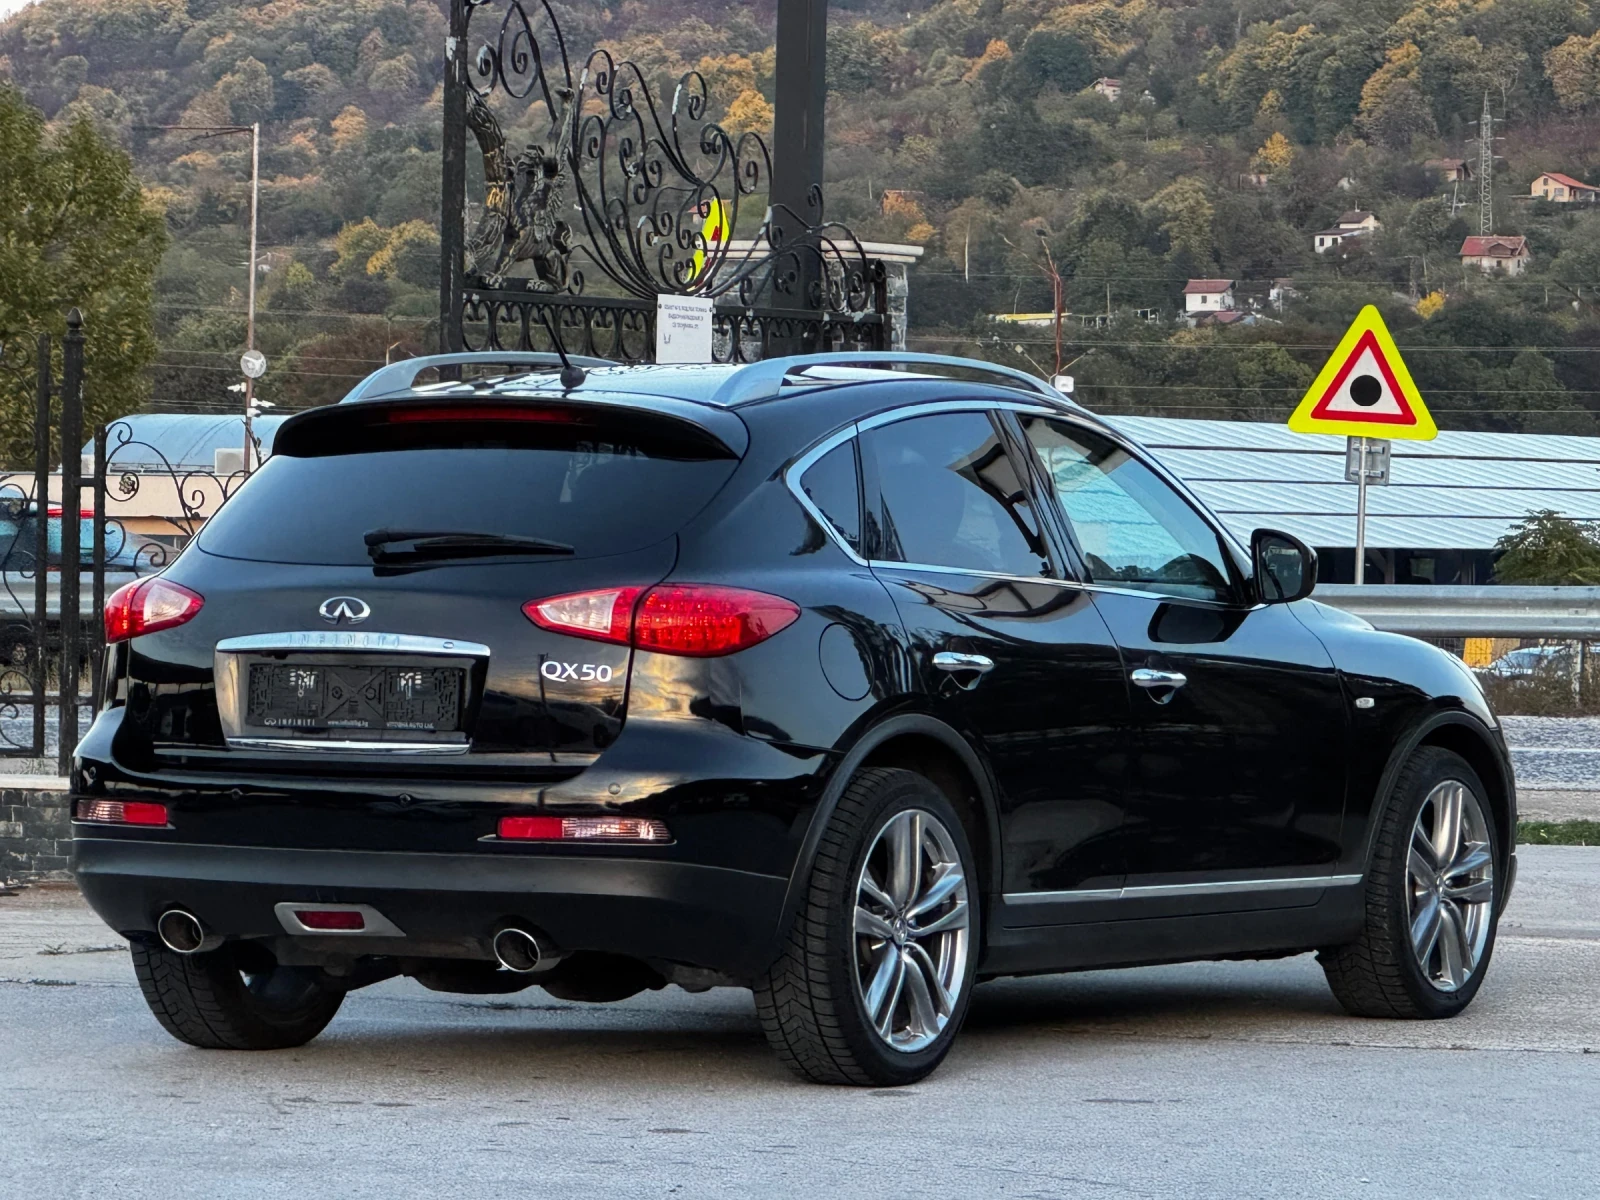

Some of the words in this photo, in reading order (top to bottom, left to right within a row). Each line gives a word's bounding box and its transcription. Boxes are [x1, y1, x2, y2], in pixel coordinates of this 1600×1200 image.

[286, 633, 400, 648] INFINITI
[540, 660, 613, 682] QX50
[278, 718, 316, 727] INFINITI
